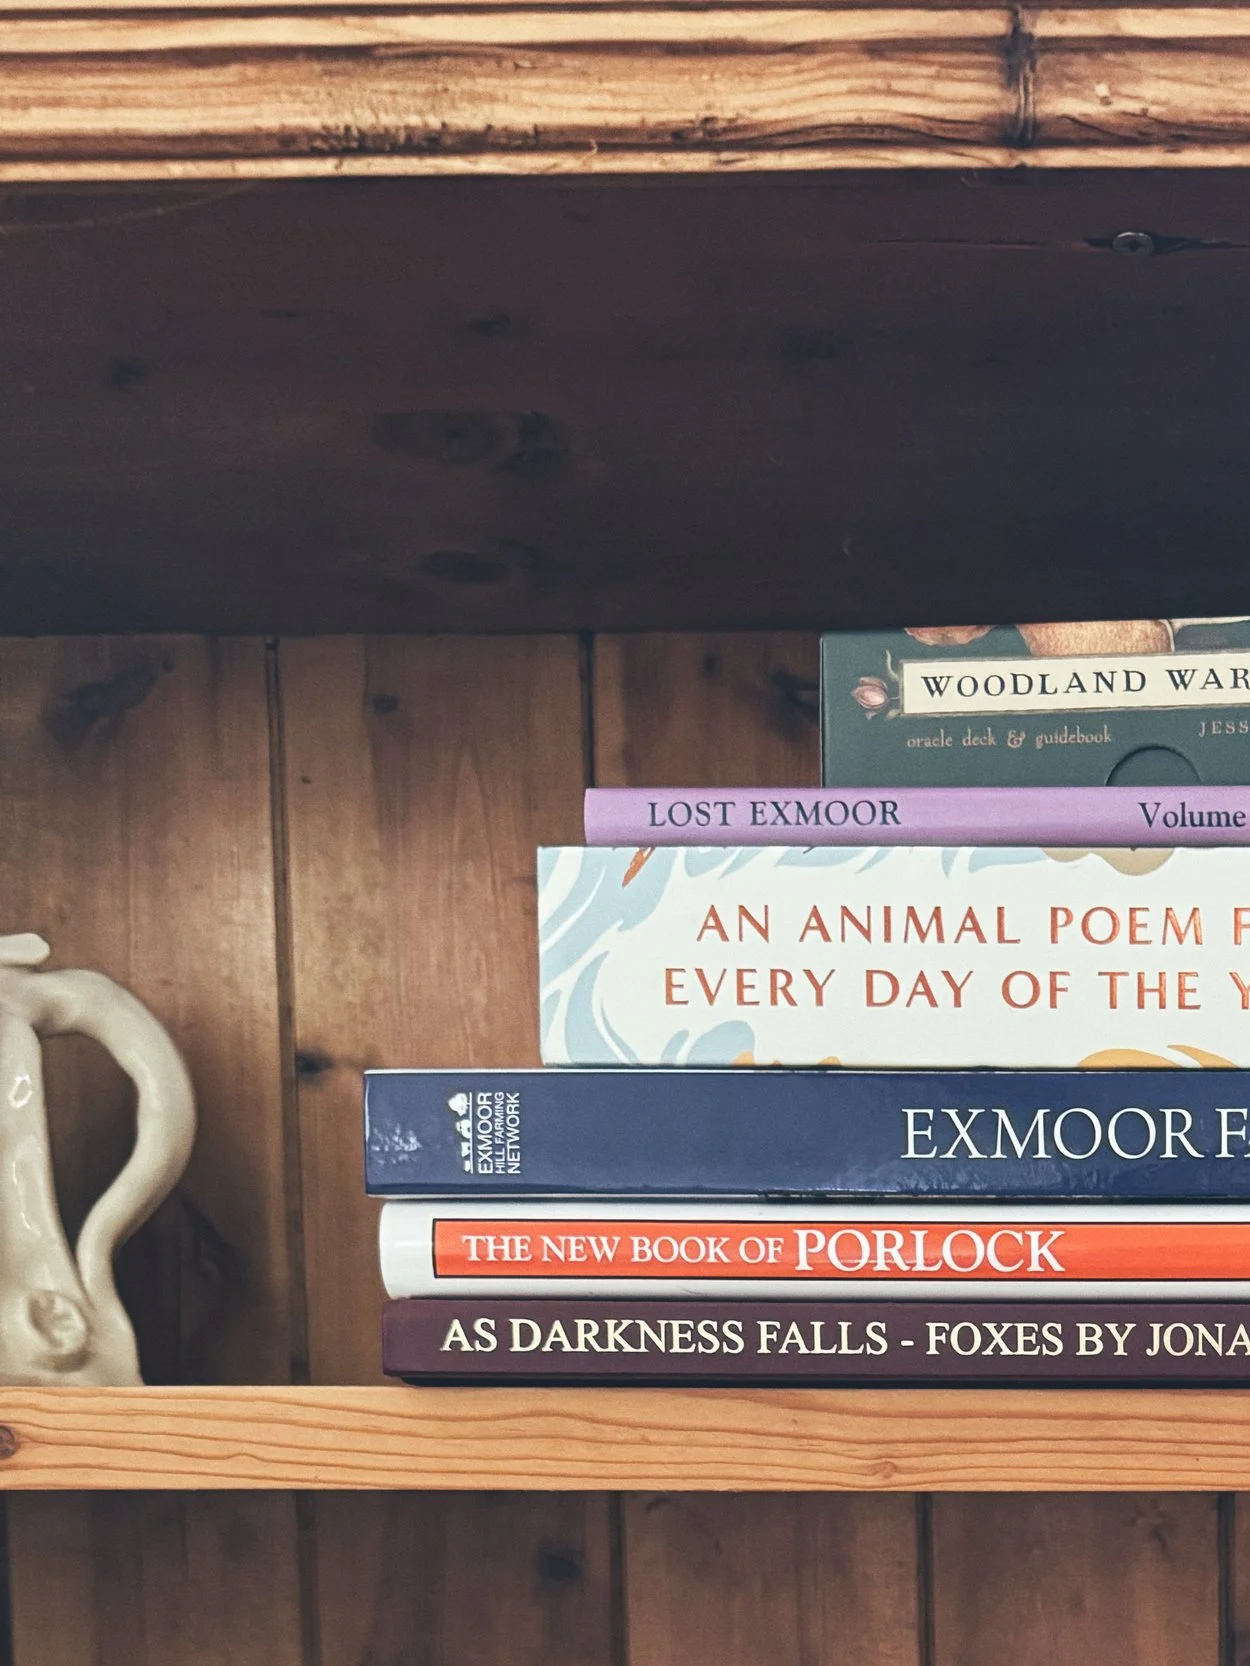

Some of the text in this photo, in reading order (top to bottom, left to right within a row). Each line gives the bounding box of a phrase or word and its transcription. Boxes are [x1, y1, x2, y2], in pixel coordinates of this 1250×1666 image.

[921, 669, 1147, 698] WOODLAND
[906, 727, 1112, 750] oracle deck & guidebook
[648, 799, 902, 828] LOST EXMOOR
[1138, 799, 1248, 830] Volume
[697, 904, 770, 943] AN
[799, 904, 1022, 945] ANIMAL
[1050, 906, 1204, 946] POEM
[664, 967, 836, 1008] EVERY
[865, 969, 973, 1008] DAY
[1001, 970, 1070, 1009] OF
[1098, 971, 1202, 1010] THE
[477, 1092, 494, 1174] EXMOOR
[494, 1091, 505, 1174] HILL FARMING
[506, 1092, 521, 1174] NETWORK
[902, 1106, 1204, 1160] EXMOOR
[463, 1229, 1066, 1272] THE NEW BOOK OF PORLOCK
[441, 1318, 498, 1352] AS
[508, 1319, 744, 1354] DARKNESS
[757, 1320, 888, 1355] FALLS
[925, 1321, 1064, 1356] FOXES
[1074, 1322, 1136, 1357] BY
